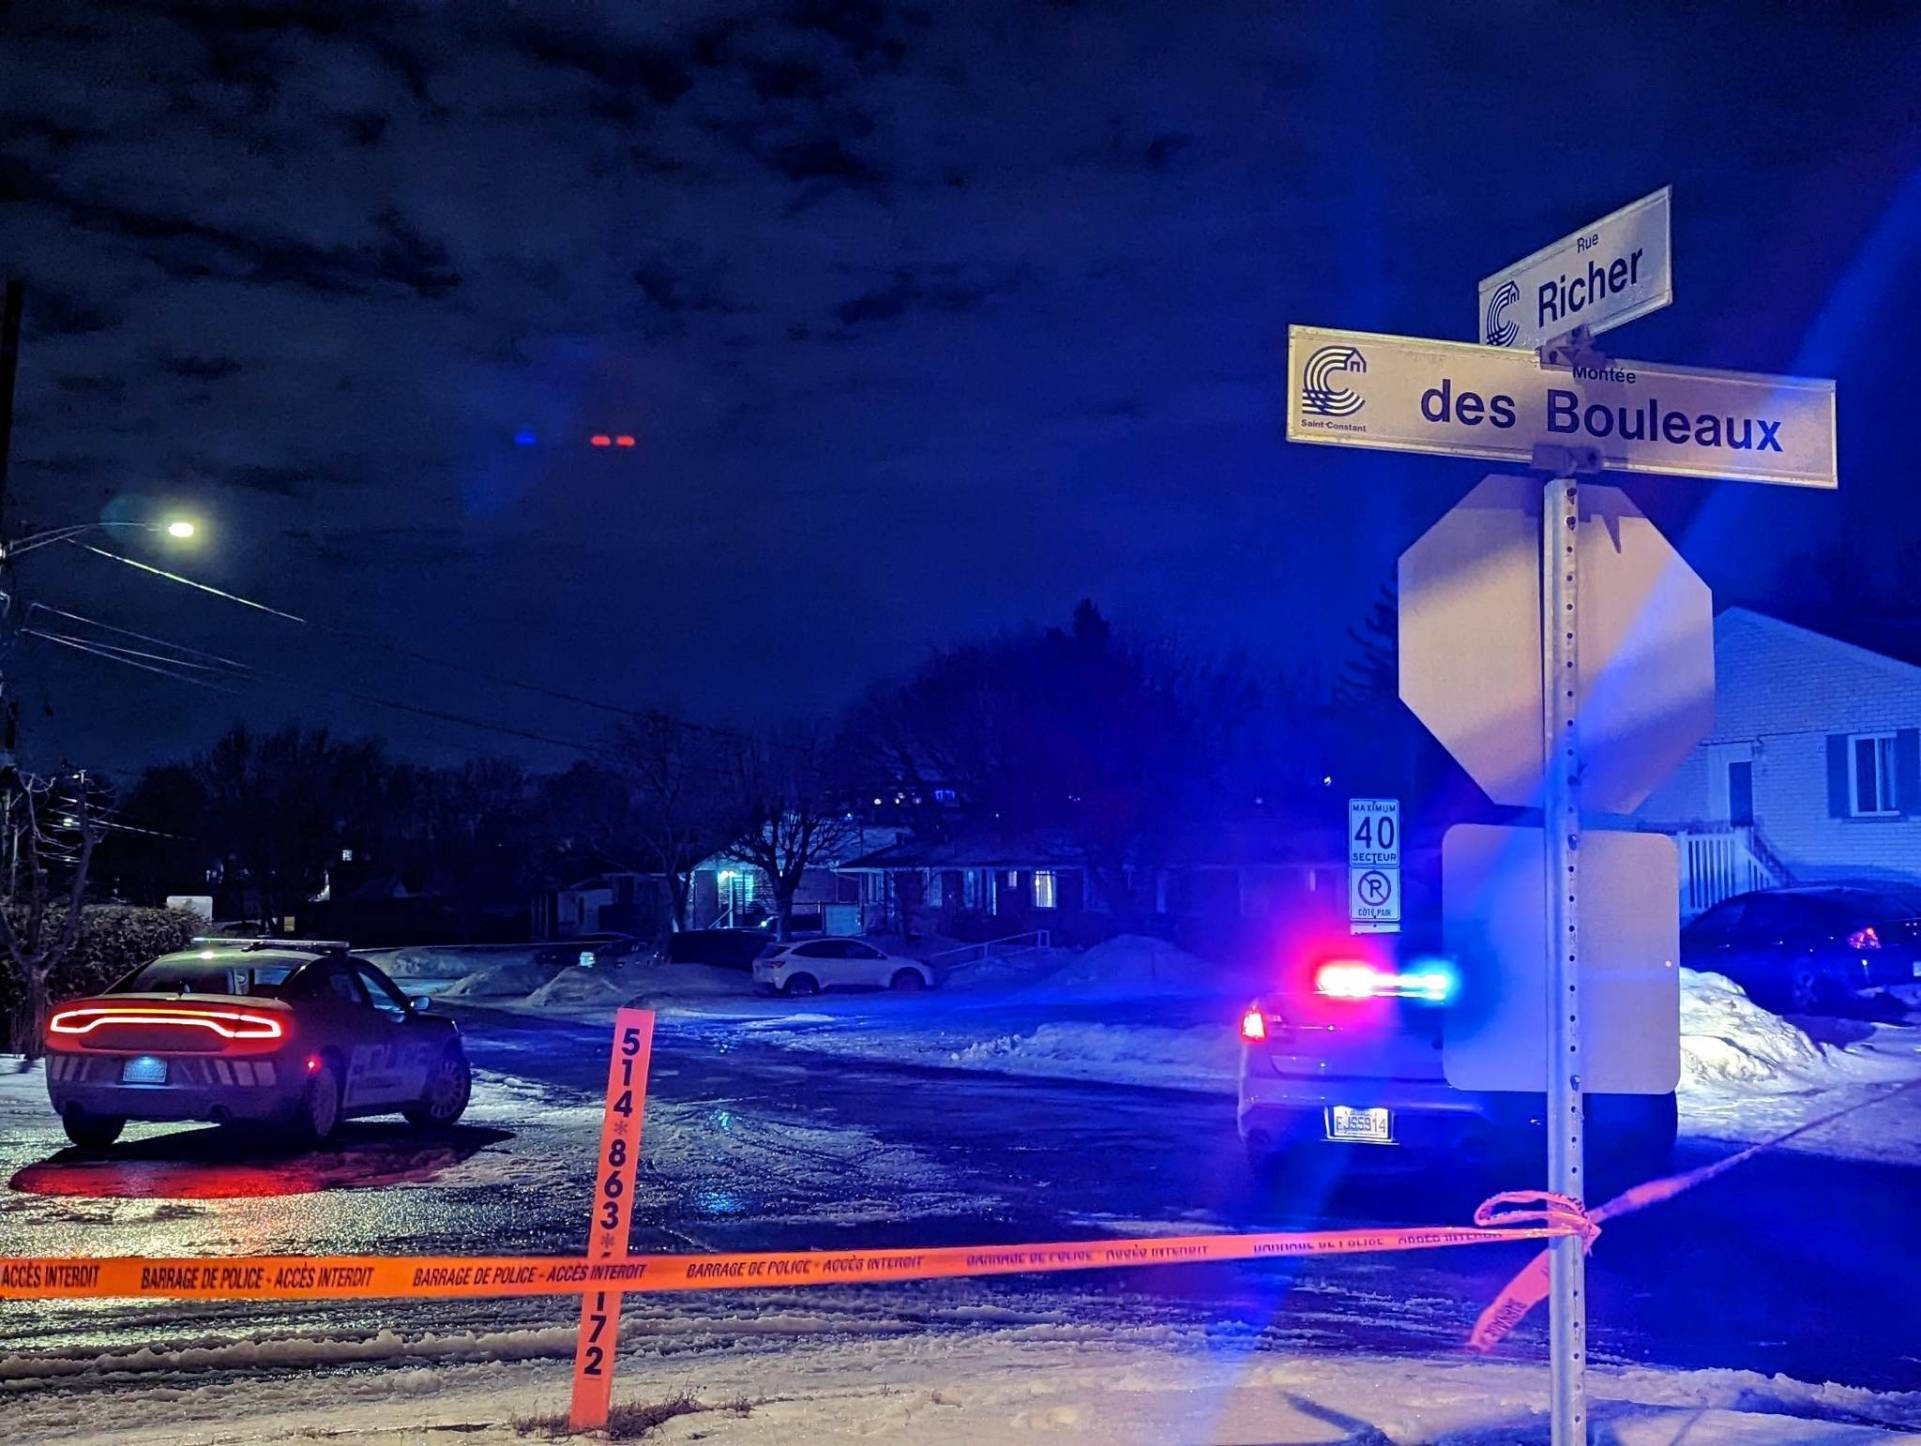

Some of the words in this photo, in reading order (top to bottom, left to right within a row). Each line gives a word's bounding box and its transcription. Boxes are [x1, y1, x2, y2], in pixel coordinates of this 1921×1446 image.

[1576, 233, 1599, 253] Rue
[1538, 248, 1643, 329] Richer
[1572, 365, 1636, 384] Montée
[1420, 379, 1516, 429] des
[1547, 388, 1784, 452] Bouleaux
[1352, 804, 1396, 812] MAXIMUM
[1354, 816, 1395, 849] 40
[1352, 852, 1397, 862] SECTEUR
[2, 1262, 42, 1288] ACCÈS
[45, 1265, 100, 1288] INTERDIT
[141, 1267, 199, 1290] BARRAGE
[201, 1267, 218, 1290] DE
[220, 1267, 265, 1289] POLICE
[274, 1261, 316, 1289] ACCÈS
[317, 1266, 375, 1288] INTERDIT
[412, 1267, 473, 1287] BARRAGE
[473, 1266, 492, 1285] DE
[492, 1265, 539, 1284] POLICE
[546, 1260, 588, 1283] ACCÈS
[589, 1263, 648, 1281] INTERDIT
